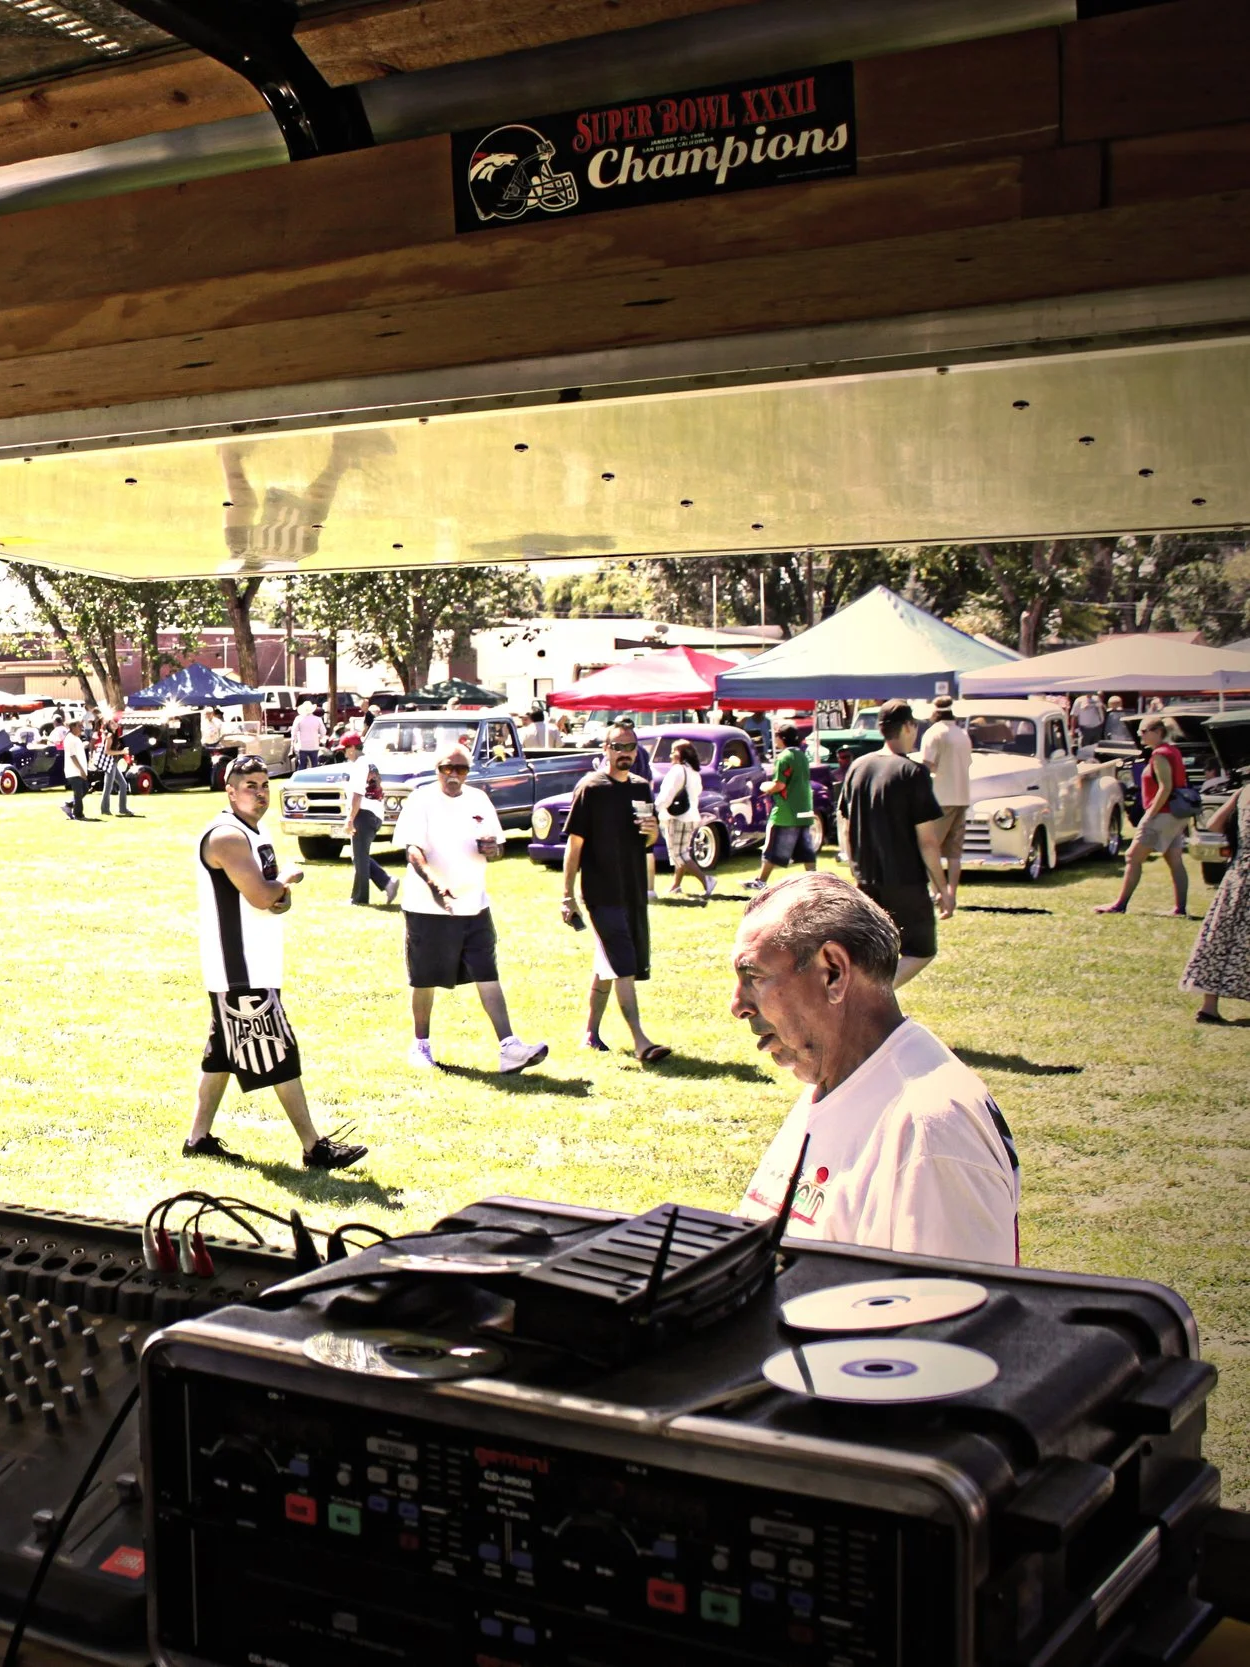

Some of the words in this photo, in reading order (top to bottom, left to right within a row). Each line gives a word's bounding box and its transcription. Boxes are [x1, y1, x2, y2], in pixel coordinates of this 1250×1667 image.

[573, 103, 654, 154] SUPER
[655, 91, 736, 134] BOWL
[742, 77, 817, 126] XXXII
[650, 136, 678, 146] JANUARY
[677, 136, 715, 148] CALIFORNIA
[587, 122, 849, 189] Champions
[474, 1447, 549, 1474] gemini
